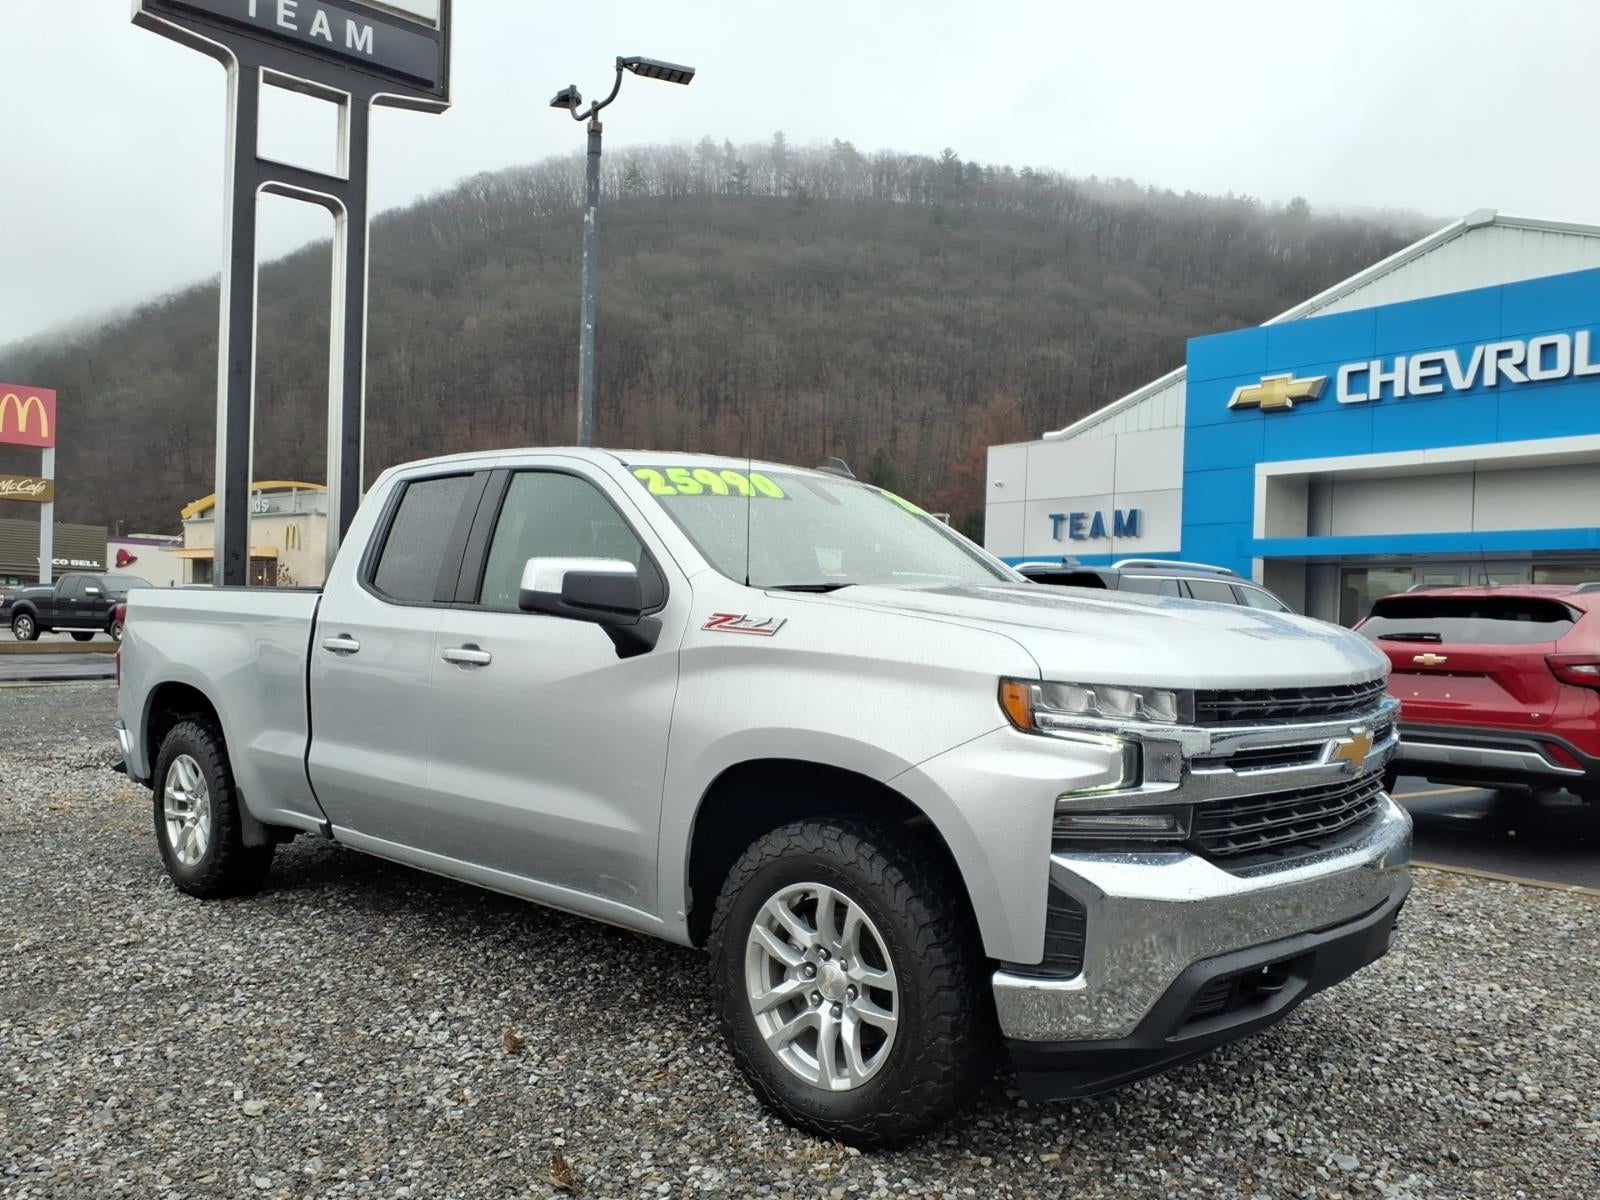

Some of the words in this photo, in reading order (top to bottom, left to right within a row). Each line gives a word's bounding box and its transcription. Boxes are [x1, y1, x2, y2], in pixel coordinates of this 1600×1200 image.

[1336, 330, 1600, 405] CHEVROL
[633, 468, 785, 499] 25990
[1048, 508, 1142, 542] TEAM
[70, 559, 101, 568] BELL
